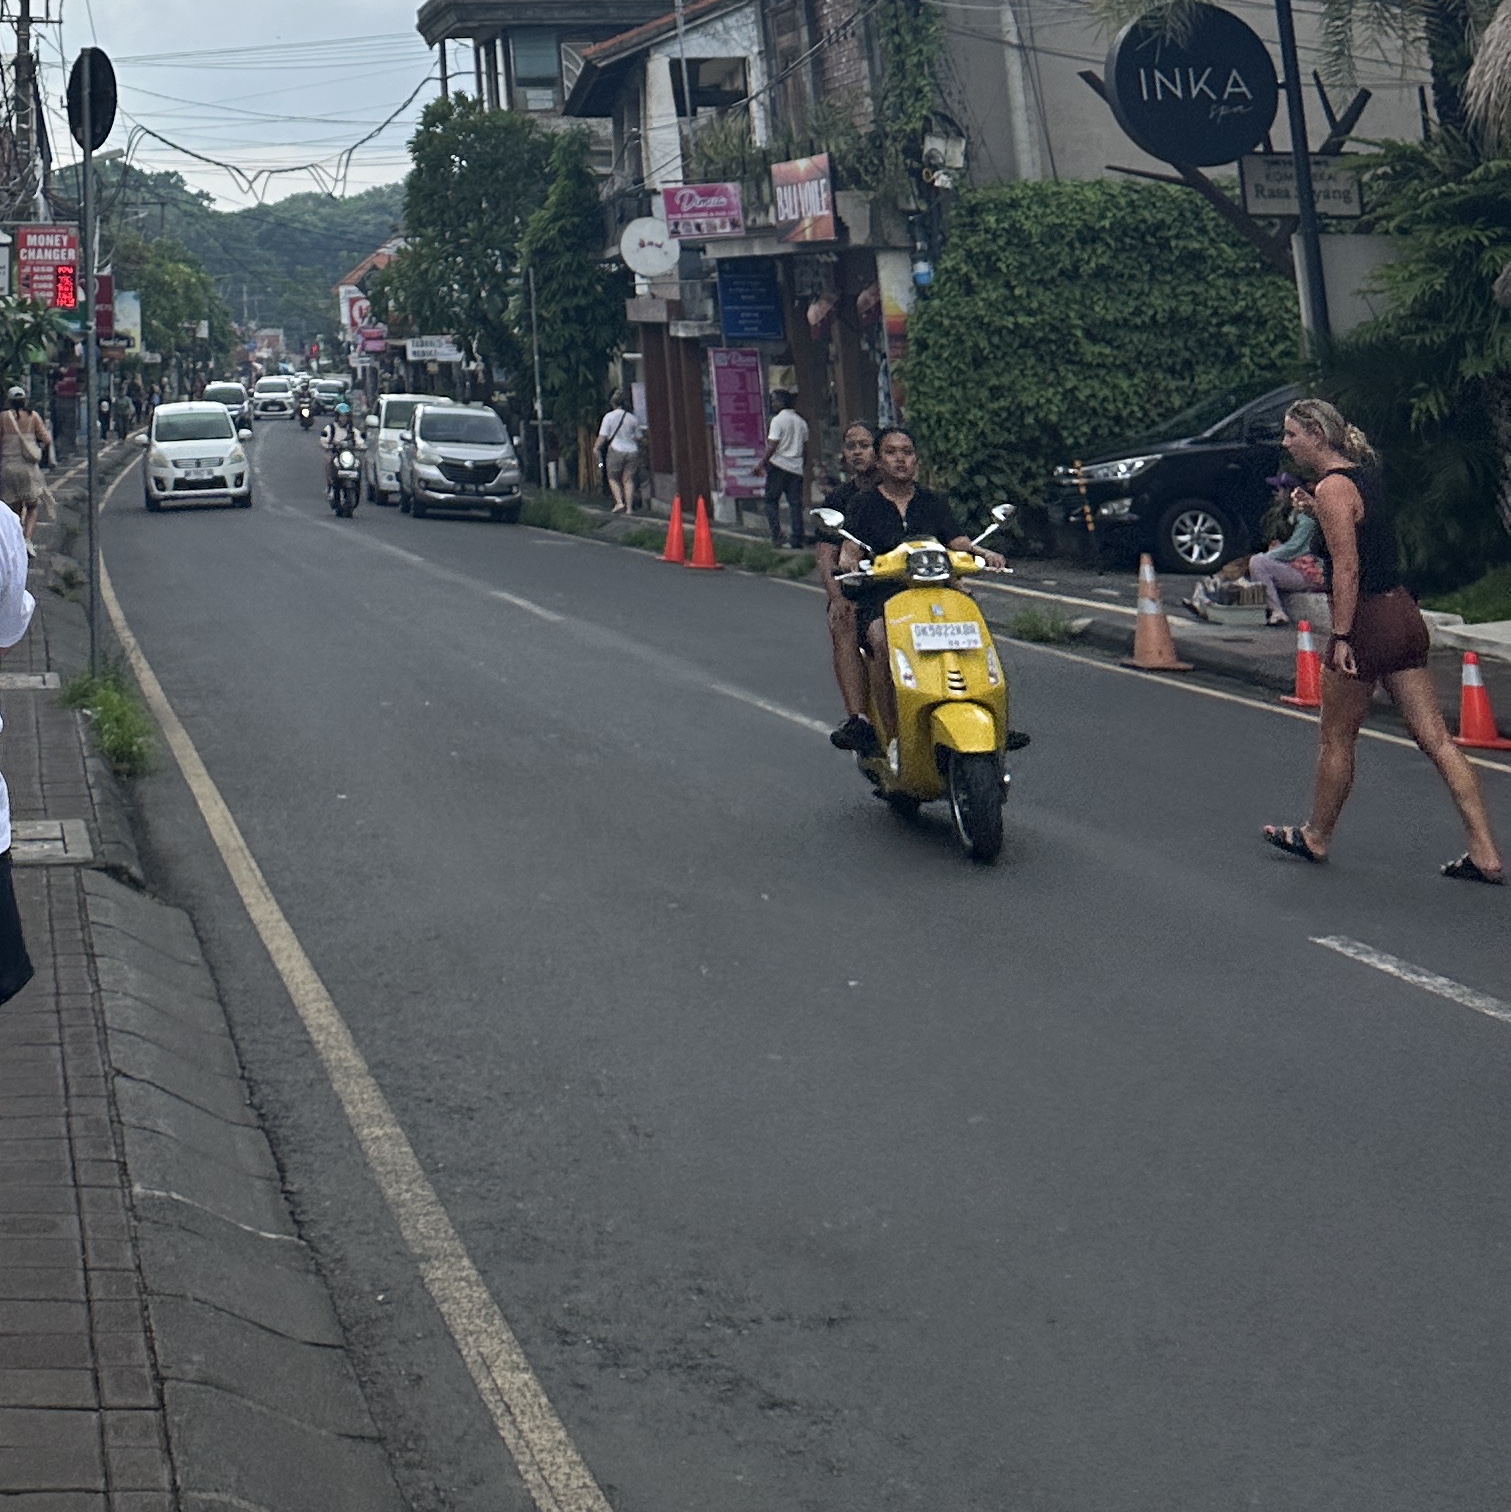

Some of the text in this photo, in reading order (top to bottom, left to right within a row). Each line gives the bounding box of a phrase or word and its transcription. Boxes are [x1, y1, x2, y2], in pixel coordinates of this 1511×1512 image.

[1140, 67, 1253, 101] INKA
[1209, 104, 1253, 124] spa
[26, 234, 68, 247] MONEY
[19, 248, 76, 261] CHANGER
